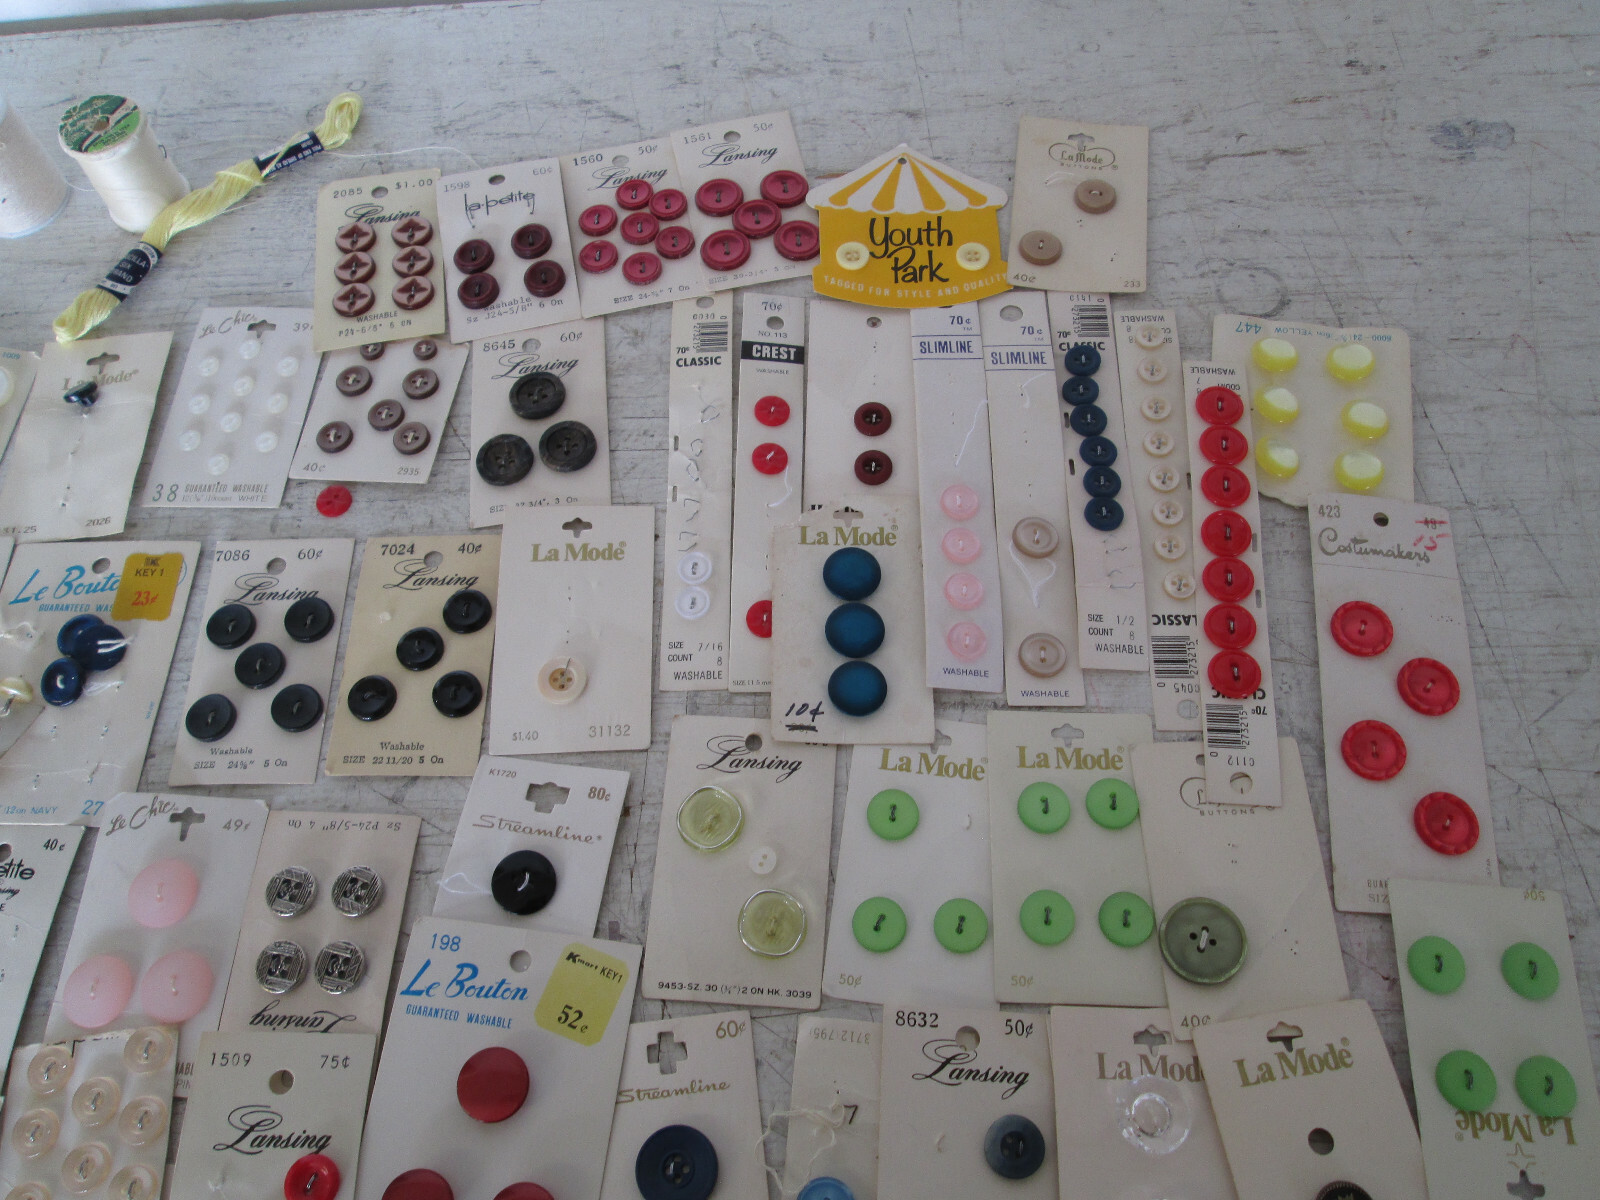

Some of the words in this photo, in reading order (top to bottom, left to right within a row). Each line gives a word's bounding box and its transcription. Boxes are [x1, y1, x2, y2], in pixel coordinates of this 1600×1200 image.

[683, 132, 712, 145] 1561
[638, 145, 658, 155] 50¢
[698, 143, 778, 168] Lansing
[573, 153, 603, 166] 1560
[395, 178, 434, 190] $1.00
[443, 180, 470, 192] 1598
[333, 187, 363, 199] 2085
[869, 215, 953, 259] Youth
[886, 246, 949, 283] Park
[824, 274, 864, 292] TAGGED
[868, 284, 890, 297] FOR
[896, 287, 932, 298] STYLE
[937, 285, 959, 296] AND
[963, 272, 1008, 292] QUALITY
[1013, 273, 1036, 283] 40¢
[761, 301, 783, 313] 70¢
[356, 310, 398, 323] WASHABLE
[1120, 315, 1165, 323] WASHABLE
[1235, 321, 1261, 334] 447
[560, 331, 583, 343] 60¢
[483, 339, 515, 352] 8645
[751, 344, 797, 361] CREST
[919, 340, 974, 355] SLIMLINE
[491, 351, 580, 380] Lansing
[676, 356, 722, 367] CLASSIC
[991, 351, 1047, 366] SLIMLINE
[1190, 366, 1236, 376] WASHABLE
[303, 462, 326, 472] 40¢
[397, 466, 419, 476] 2935
[152, 483, 178, 502] 38
[184, 484, 227, 493] GUARANTEED
[232, 484, 268, 493] WASHABLE
[1318, 504, 1341, 519] 423
[85, 516, 111, 527] 2026
[798, 525, 829, 546] La
[380, 543, 415, 556] 7024
[457, 542, 482, 555] 40¢
[530, 543, 560, 562] La
[1318, 527, 1430, 564] Costumakers
[216, 548, 250, 562] 7086
[297, 548, 323, 560] 60¢
[134, 568, 157, 577] KEY
[383, 558, 479, 591] Lansing
[9, 568, 48, 605] Le
[38, 604, 90, 612] GUARANTEED
[1088, 614, 1104, 622] SIZE
[1116, 615, 1135, 626] 1/2
[1088, 627, 1114, 637] COUNT
[668, 641, 684, 649] SIZE
[1095, 643, 1144, 655] WASHABLE
[667, 653, 693, 662] COUNT
[1185, 640, 1199, 675] 273215
[673, 670, 723, 681] WASHABLE
[943, 667, 989, 678] WASHABLE
[1021, 689, 1070, 698] WASHABLE
[588, 724, 632, 738] 31132
[1238, 710, 1250, 747] 273215
[512, 730, 539, 742] $1.40
[209, 747, 253, 756] Washable
[380, 741, 425, 752] Washable
[193, 760, 216, 769] SIZE
[263, 759, 270, 767] 5
[275, 759, 288, 767] On
[342, 755, 366, 764] SIZE
[372, 755, 384, 764] 22
[418, 755, 425, 764] 5
[430, 755, 444, 764] On
[696, 734, 803, 783] Lansing
[877, 747, 911, 773] La
[1016, 745, 1050, 770] La
[1227, 754, 1255, 768] C112
[488, 768, 517, 778] K1720
[587, 786, 611, 802] 80¢
[81, 799, 104, 816] 27
[106, 816, 126, 837] Le
[222, 818, 251, 832] 49¢
[288, 820, 301, 829] On
[309, 820, 316, 829] 4
[472, 814, 595, 845] Streamline
[43, 838, 66, 852] 40¢
[431, 933, 462, 952] 198
[565, 951, 599, 970] Kmart
[400, 957, 440, 998] Le
[445, 962, 529, 1001] Bouton
[838, 973, 862, 989] 50¢
[1011, 974, 1034, 988] 50¢
[705, 983, 718, 993] 30
[750, 987, 764, 995] ON
[785, 989, 812, 999] 3039
[405, 1003, 460, 1022] GUARANTEED
[466, 1012, 513, 1030] WASHABLE
[557, 1004, 589, 1033] 52¢
[895, 1010, 939, 1028] 8632
[1180, 1014, 1211, 1028] 40¢
[716, 1020, 747, 1040] 60¢
[1004, 1018, 1034, 1039] 50¢
[842, 1031, 871, 1046] 3712
[211, 1052, 252, 1067] 1509
[320, 1054, 350, 1070] 75¢
[1096, 1052, 1132, 1081] La
[911, 1038, 1030, 1100] Lansing
[1233, 1058, 1276, 1087] La
[615, 1079, 731, 1104] Streamline
[213, 1104, 333, 1155] Lansing
[1537, 1115, 1578, 1146] La
